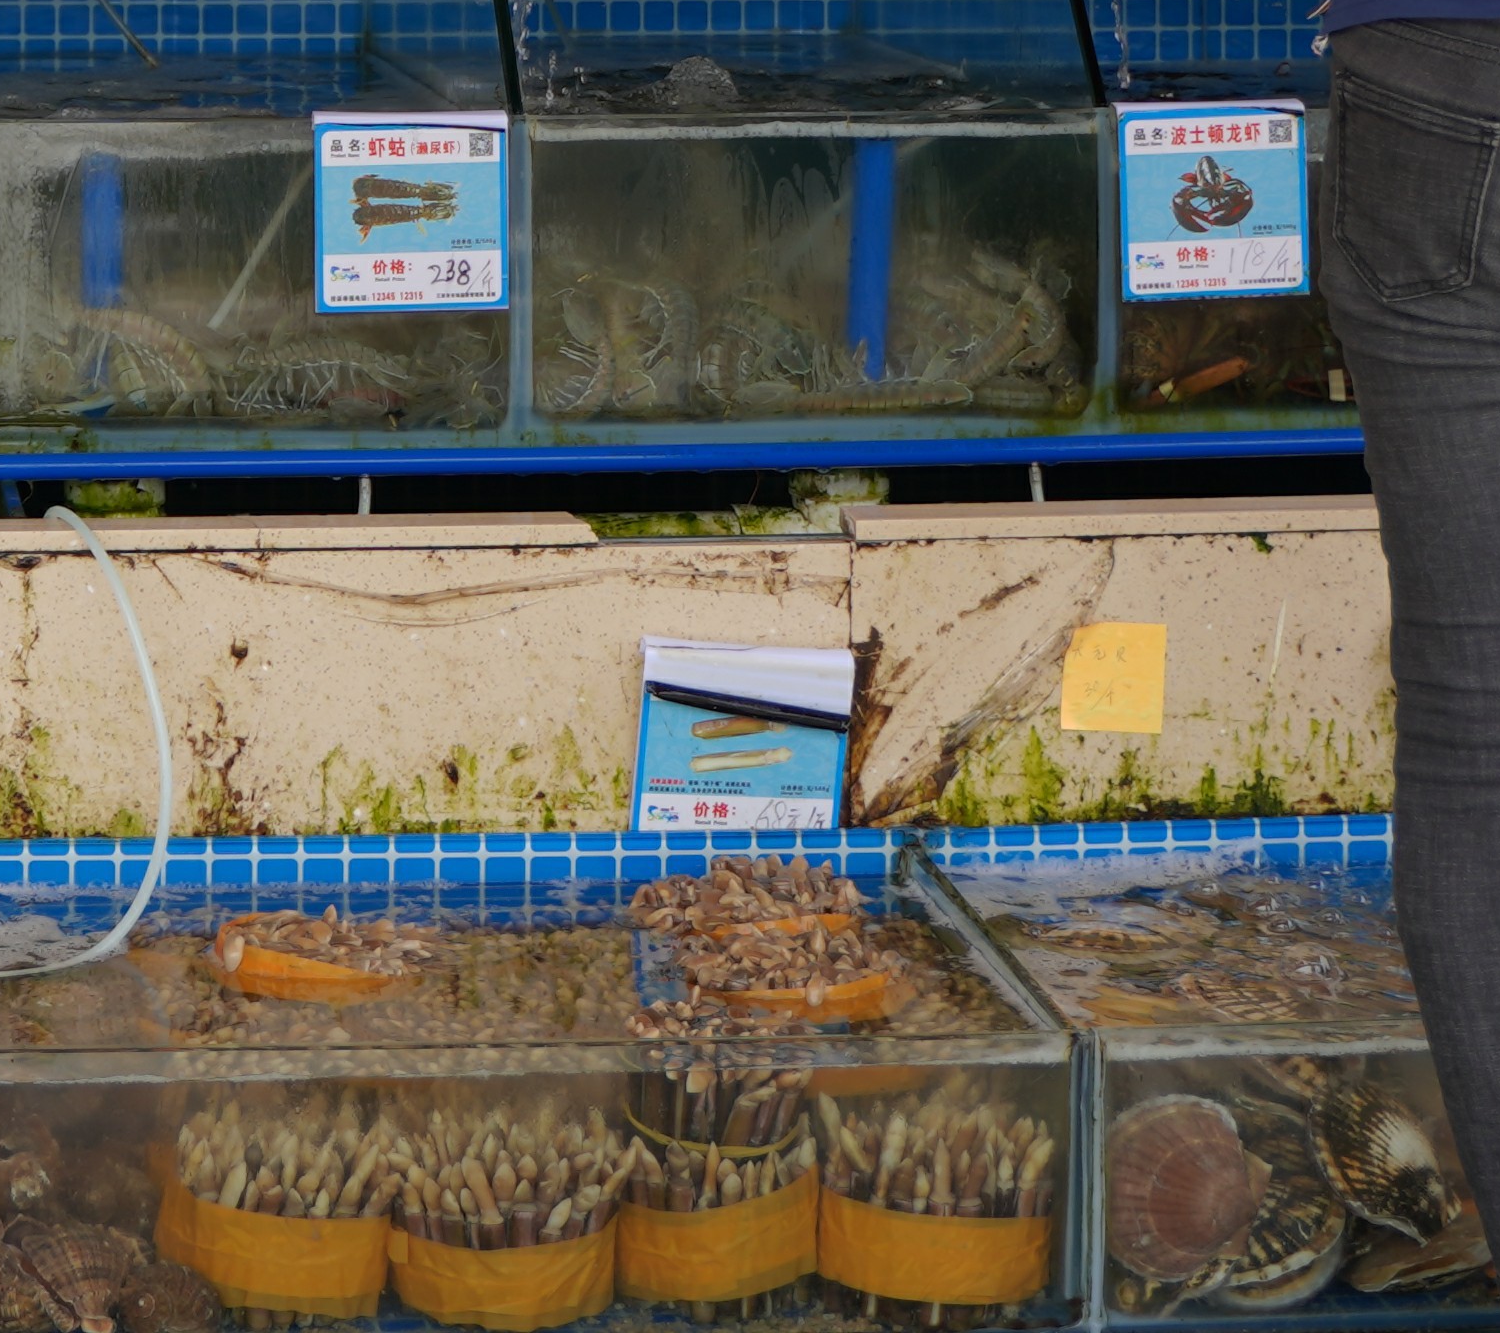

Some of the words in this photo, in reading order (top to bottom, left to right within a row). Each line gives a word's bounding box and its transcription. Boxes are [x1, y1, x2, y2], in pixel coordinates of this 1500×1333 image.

[1177, 246, 1216, 263] 价格:
[372, 259, 412, 276] 价格:
[694, 801, 736, 819] 价格:
